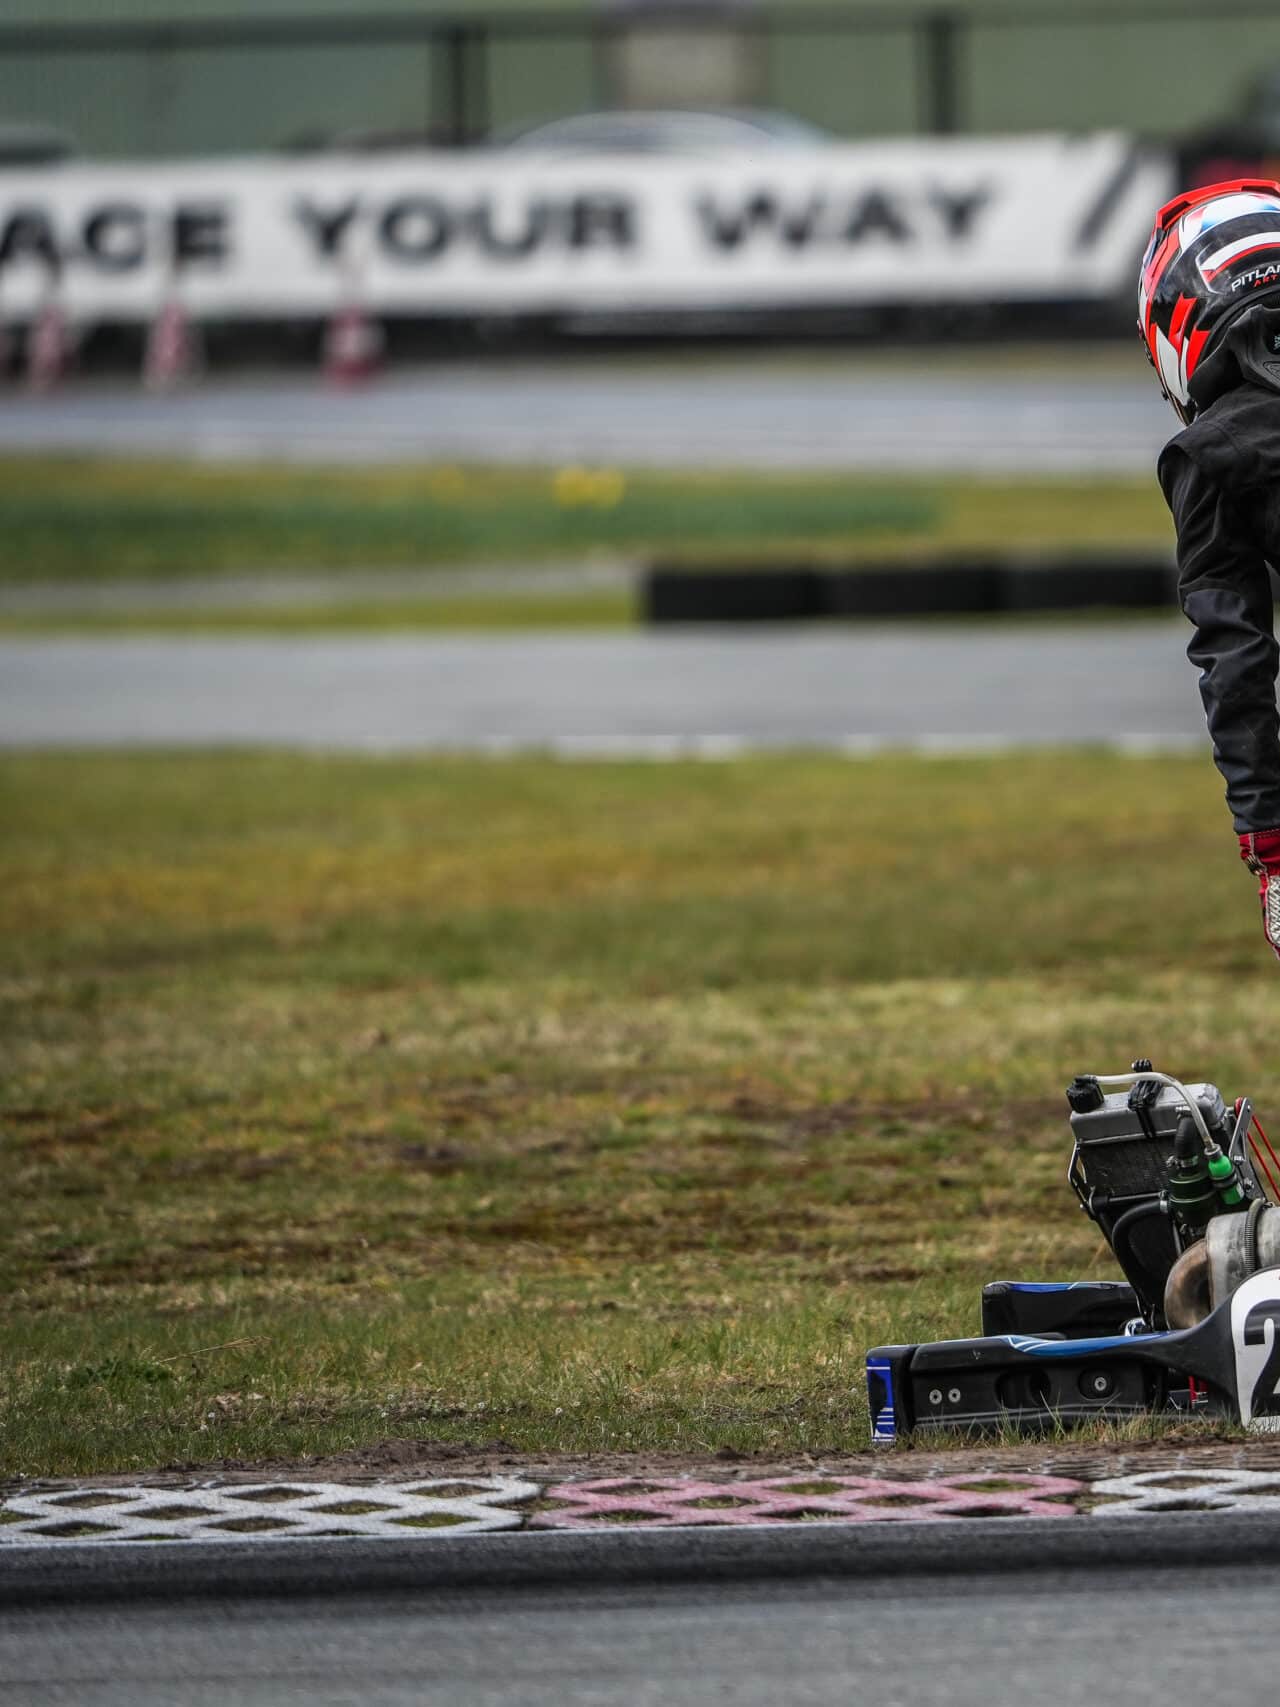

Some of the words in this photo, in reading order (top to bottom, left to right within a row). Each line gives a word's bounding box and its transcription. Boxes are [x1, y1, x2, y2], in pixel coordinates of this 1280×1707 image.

[0, 204, 229, 276] ACE
[294, 192, 636, 264] YOUR
[694, 180, 996, 258] WAY
[1253, 273, 1280, 288] ART
